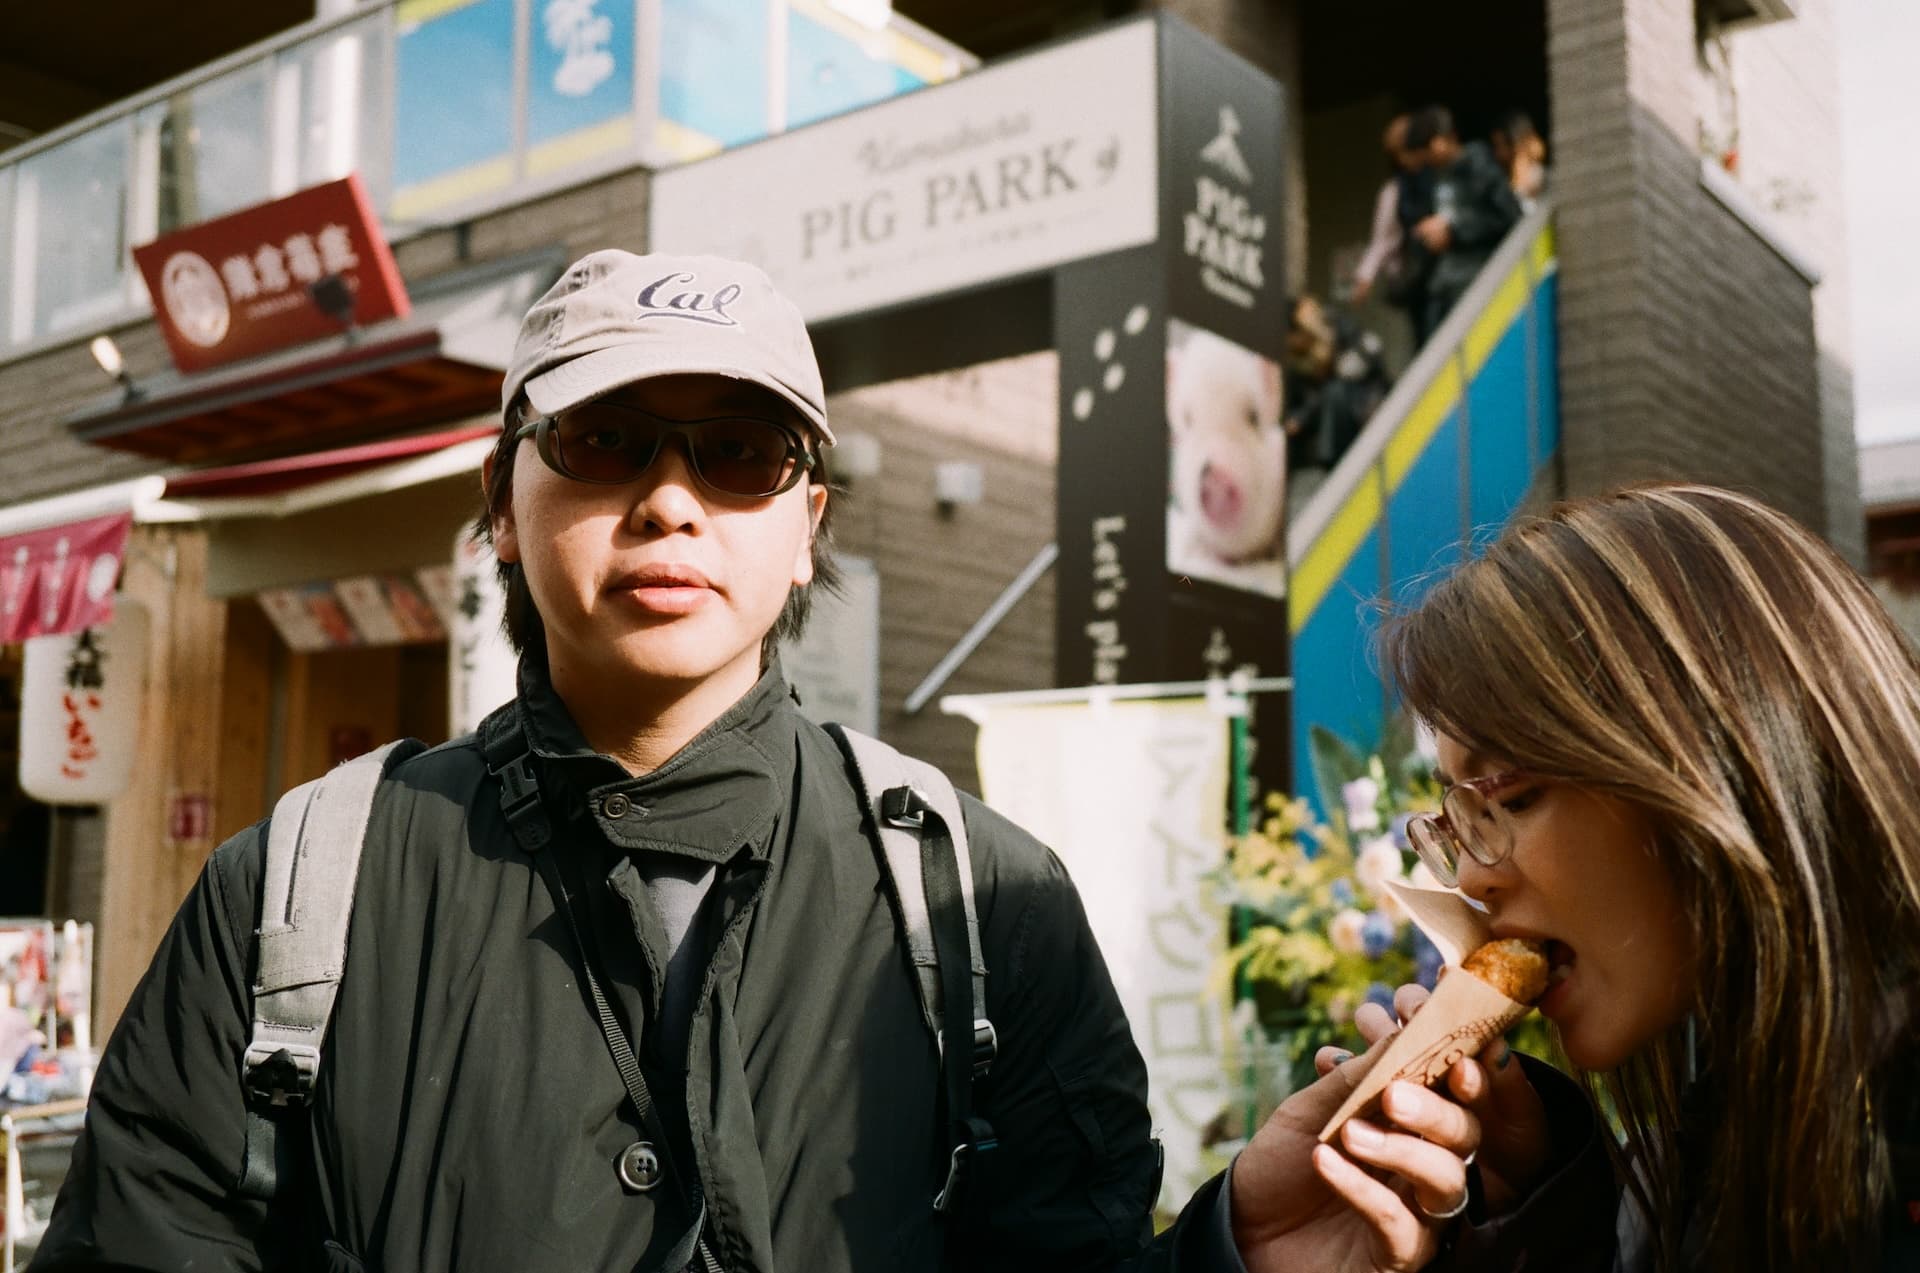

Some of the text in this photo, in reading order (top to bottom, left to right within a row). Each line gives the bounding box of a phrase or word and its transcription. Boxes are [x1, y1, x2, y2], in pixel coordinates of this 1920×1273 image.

[801, 188, 898, 260] PIG
[924, 137, 1077, 228] PARK
[1183, 213, 1265, 289] PARK
[637, 272, 742, 326] Cal
[1092, 516, 1128, 611] Let's
